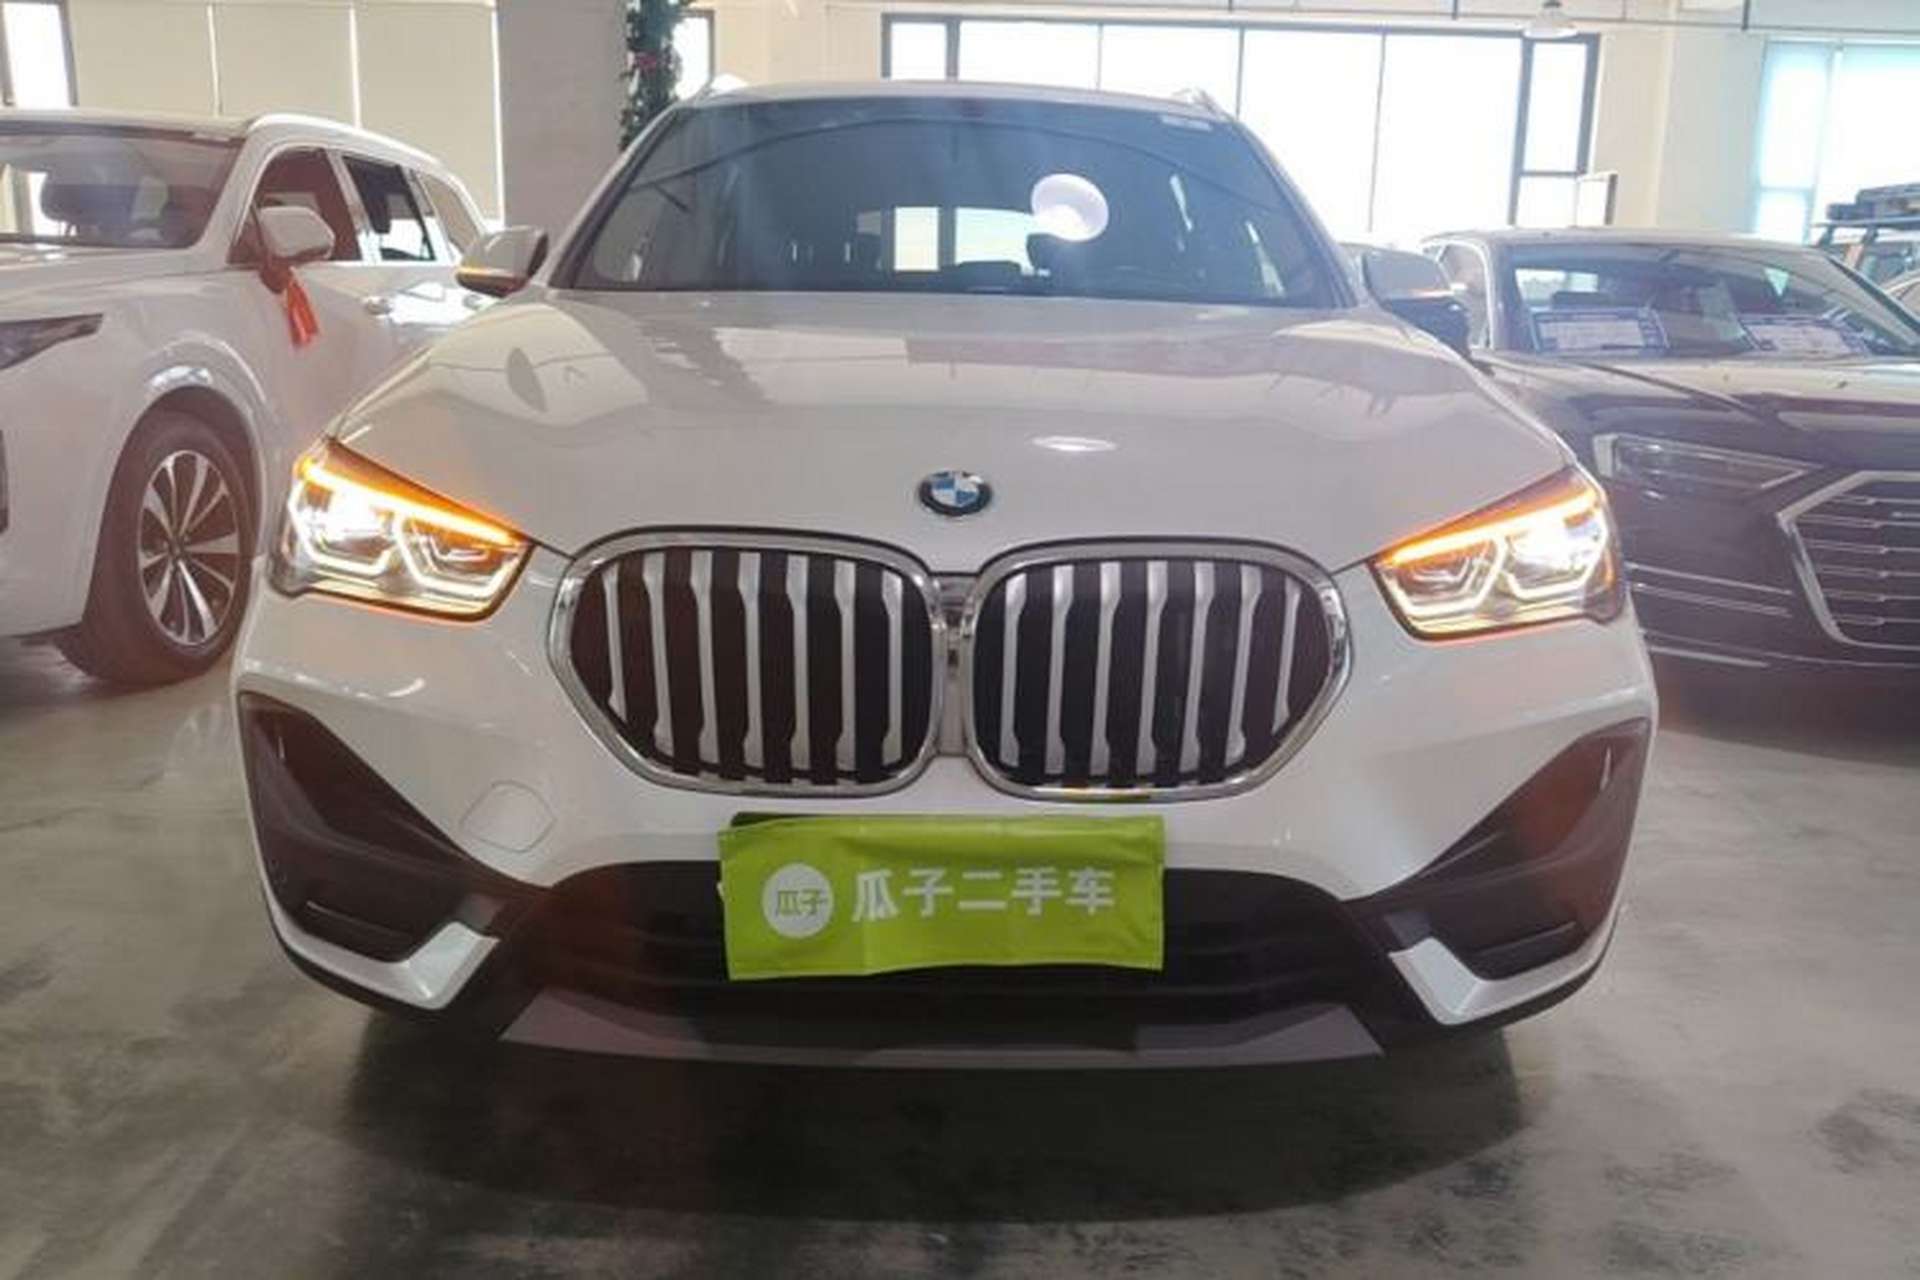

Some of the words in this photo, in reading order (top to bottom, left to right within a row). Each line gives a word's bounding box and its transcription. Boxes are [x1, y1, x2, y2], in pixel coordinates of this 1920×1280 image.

[775, 889, 828, 916] 瓜子
[852, 867, 1115, 922] 瓜子二手车
